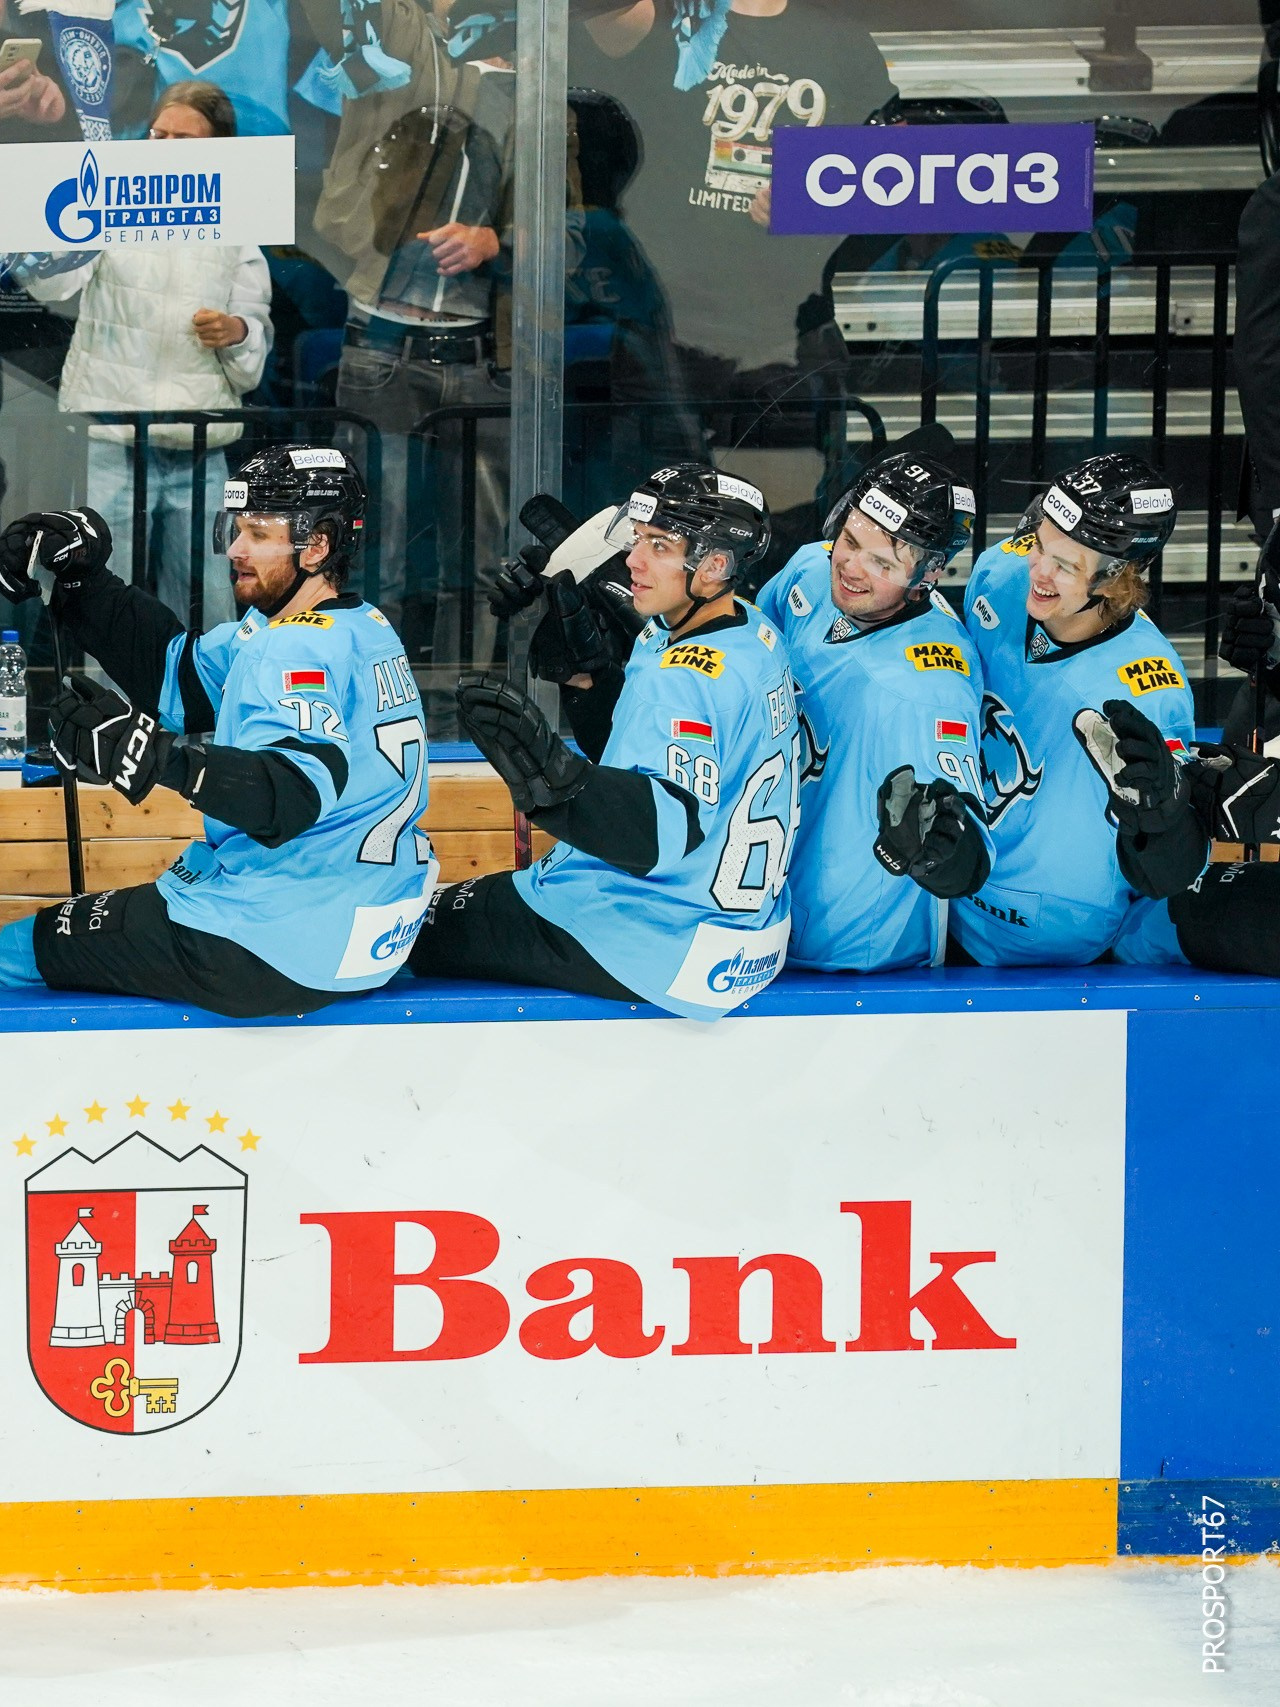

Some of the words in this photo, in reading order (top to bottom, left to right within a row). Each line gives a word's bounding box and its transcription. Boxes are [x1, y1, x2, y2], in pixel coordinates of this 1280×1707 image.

[706, 61, 756, 84] Made
[702, 78, 826, 142] 1979
[105, 173, 221, 206] ГАЗПРОМ
[688, 187, 751, 213] LIMITED
[108, 209, 219, 225] ТРАНСГАЗ
[104, 227, 221, 243] БЕЛАРУСЬ
[293, 452, 344, 466] Belavia
[650, 468, 679, 482] 68
[904, 464, 931, 483] 91
[719, 480, 763, 506] Belavia
[1072, 473, 1103, 496] 37
[729, 527, 754, 538] CCM
[605, 584, 627, 598] CCM
[278, 616, 328, 626] LINE
[670, 645, 719, 659] MAX
[913, 645, 955, 658] MAX
[669, 655, 718, 674] LINE
[922, 656, 965, 672] LINE
[1124, 659, 1168, 680] MAX
[1136, 672, 1180, 692] LINE
[277, 696, 350, 743] 72
[115, 712, 156, 791] CCM
[667, 743, 720, 807] 68
[936, 751, 986, 803] 91
[967, 895, 1031, 929] ank
[738, 949, 781, 976] ГАЗПРОМ
[299, 1200, 1018, 1365] Bank
